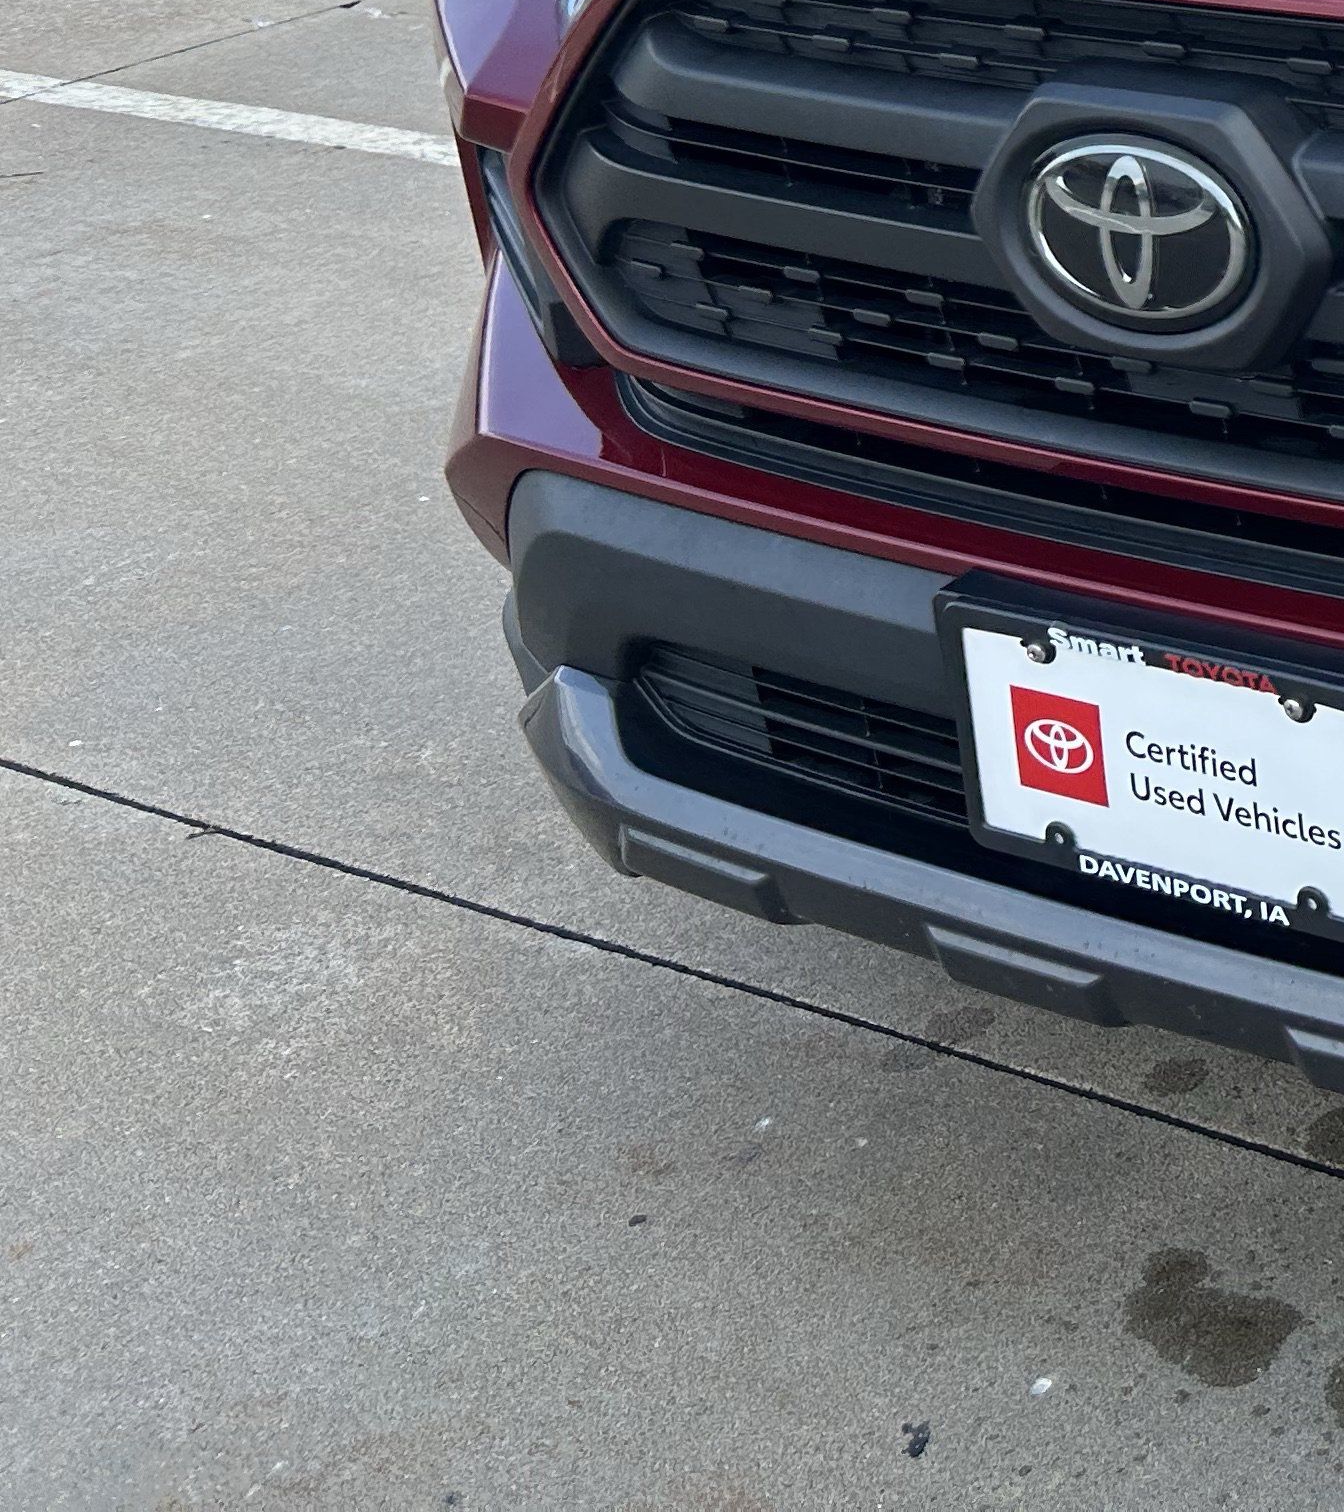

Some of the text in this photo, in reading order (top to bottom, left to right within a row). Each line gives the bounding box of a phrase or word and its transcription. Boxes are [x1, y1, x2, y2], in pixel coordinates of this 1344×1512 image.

[1047, 626, 1278, 695] Smart TOYOTA
[1125, 730, 1258, 787] Certified
[1130, 772, 1342, 850] Used Vehicles
[1078, 854, 1290, 927] DAVENPORT, IA
